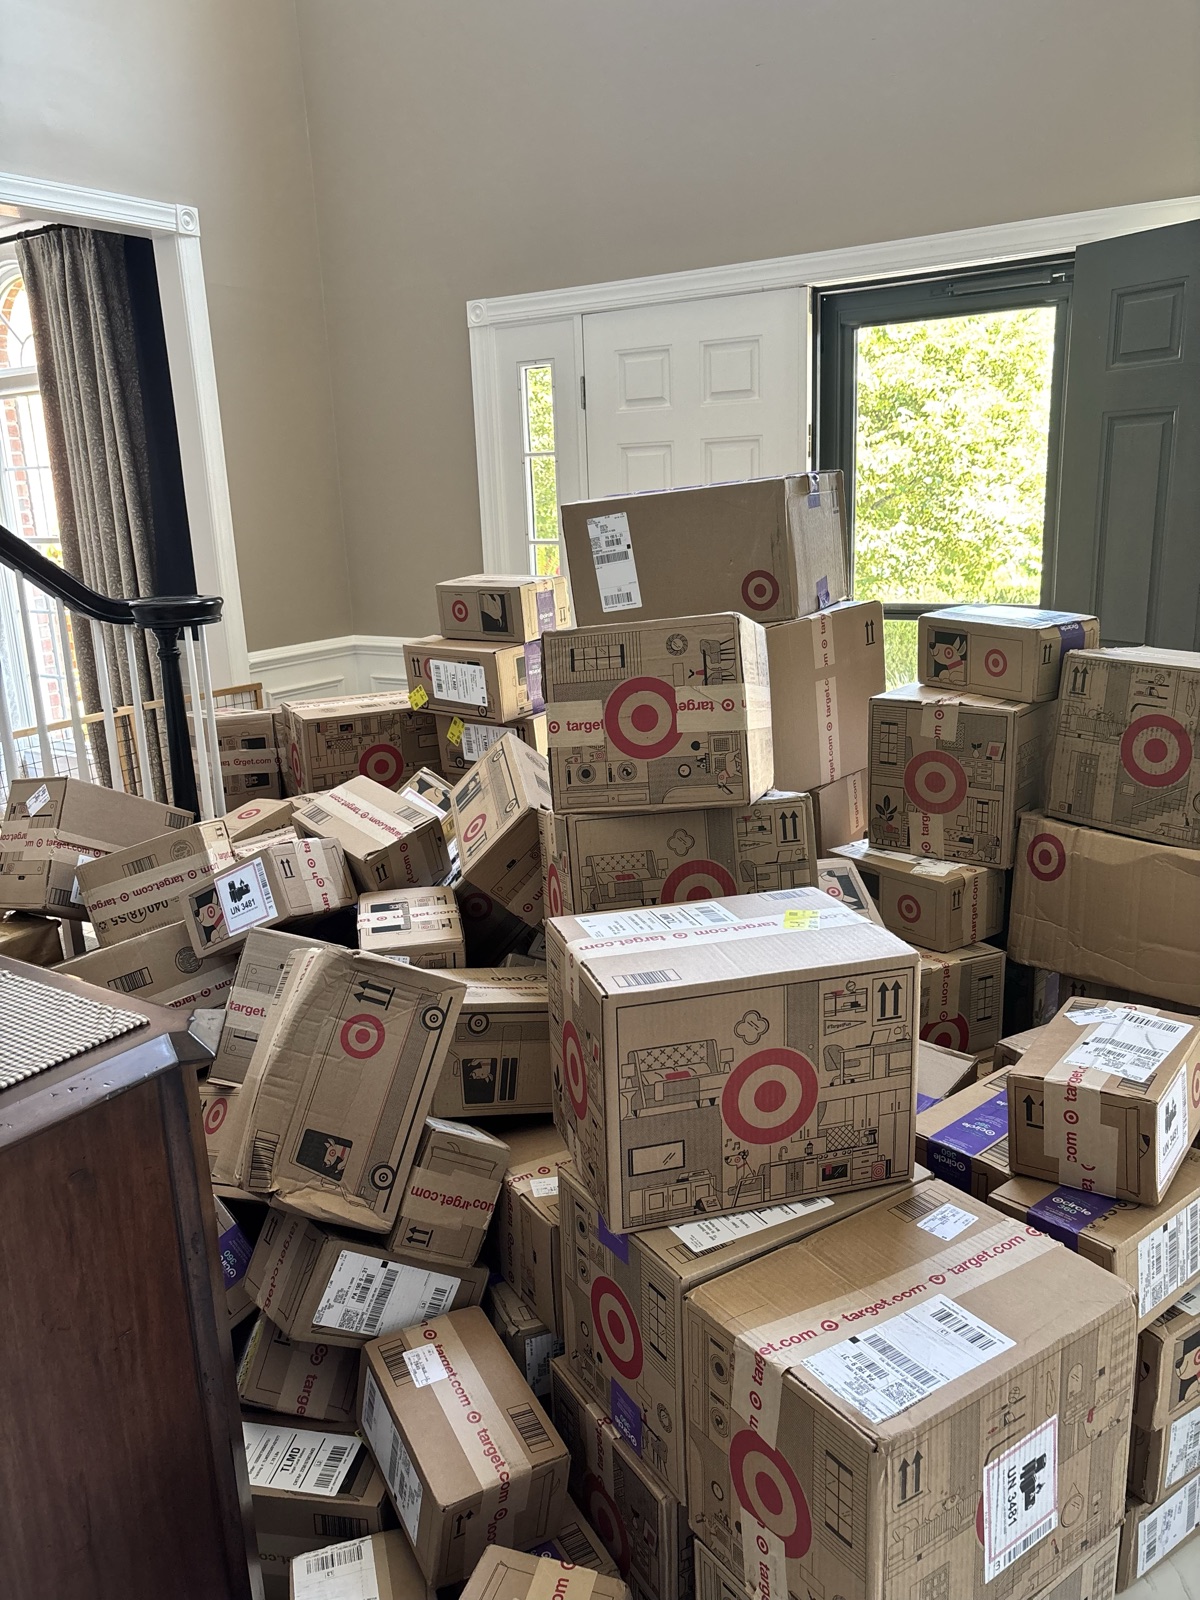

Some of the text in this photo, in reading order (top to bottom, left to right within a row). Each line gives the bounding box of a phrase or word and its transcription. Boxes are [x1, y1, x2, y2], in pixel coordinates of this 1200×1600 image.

[230, 906, 240, 916] UN
[241, 898, 256, 911] 3481
[579, 934, 667, 951] target.com
[933, 1152, 957, 1167] circle
[941, 1148, 957, 1160] 360
[1057, 1205, 1077, 1214] 360
[1063, 1200, 1092, 1216] circle
[841, 1234, 1025, 1322] target.com target.com
[280, 1447, 301, 1473] TLMD
[477, 1428, 511, 1504] target.com
[1007, 1466, 1018, 1527] UN 3481
